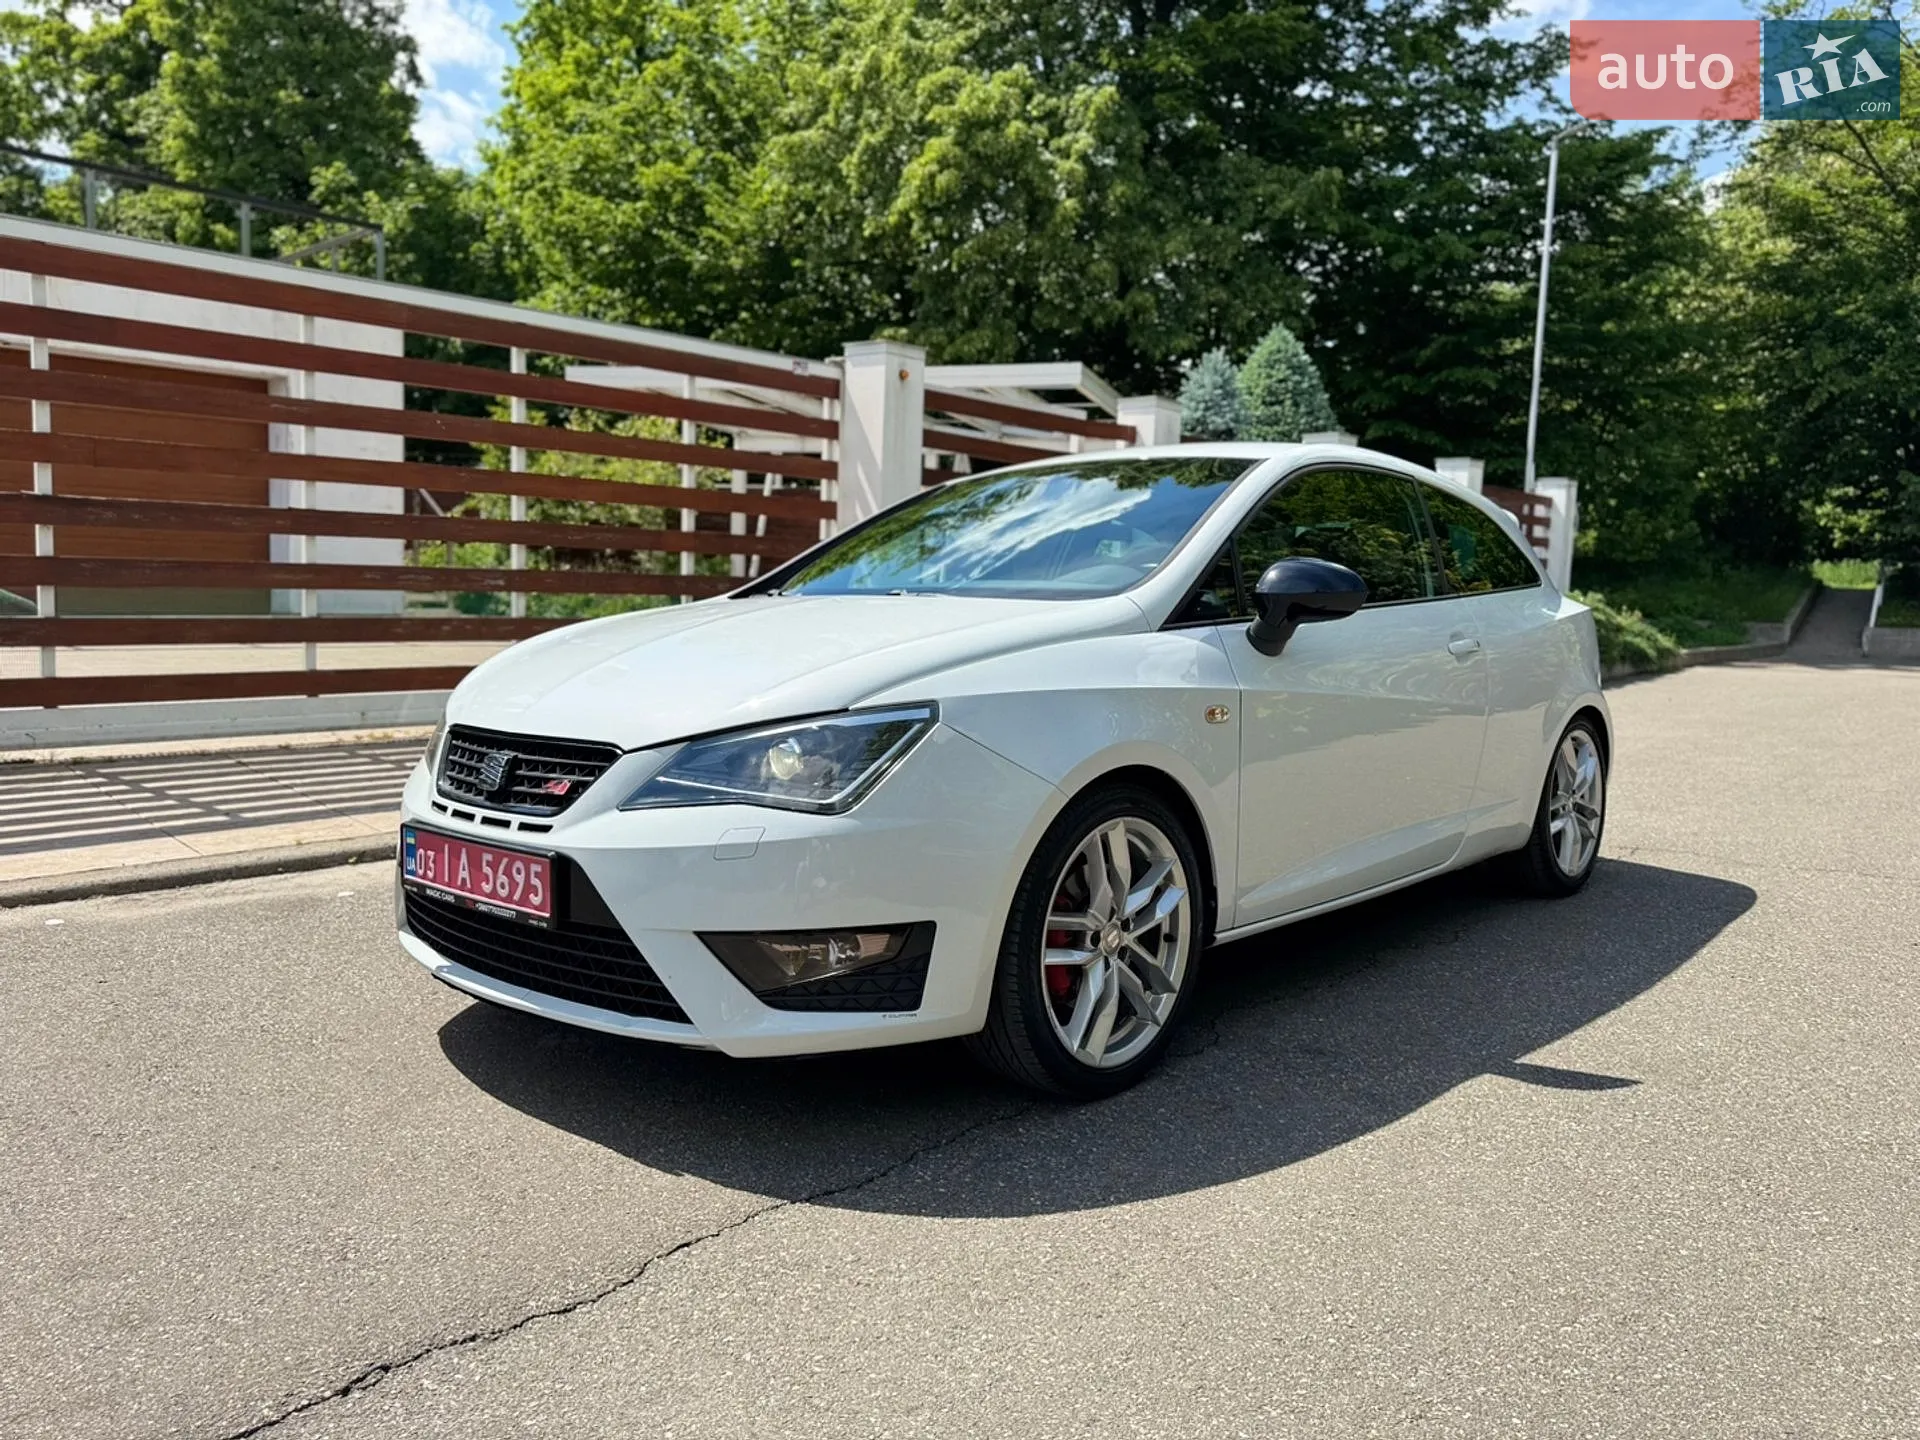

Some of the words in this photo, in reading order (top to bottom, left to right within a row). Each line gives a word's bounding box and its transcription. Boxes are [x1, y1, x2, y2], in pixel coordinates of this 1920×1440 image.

[406, 856, 416, 871] UA
[416, 848, 436, 879] 03
[480, 852, 543, 906] 5695
